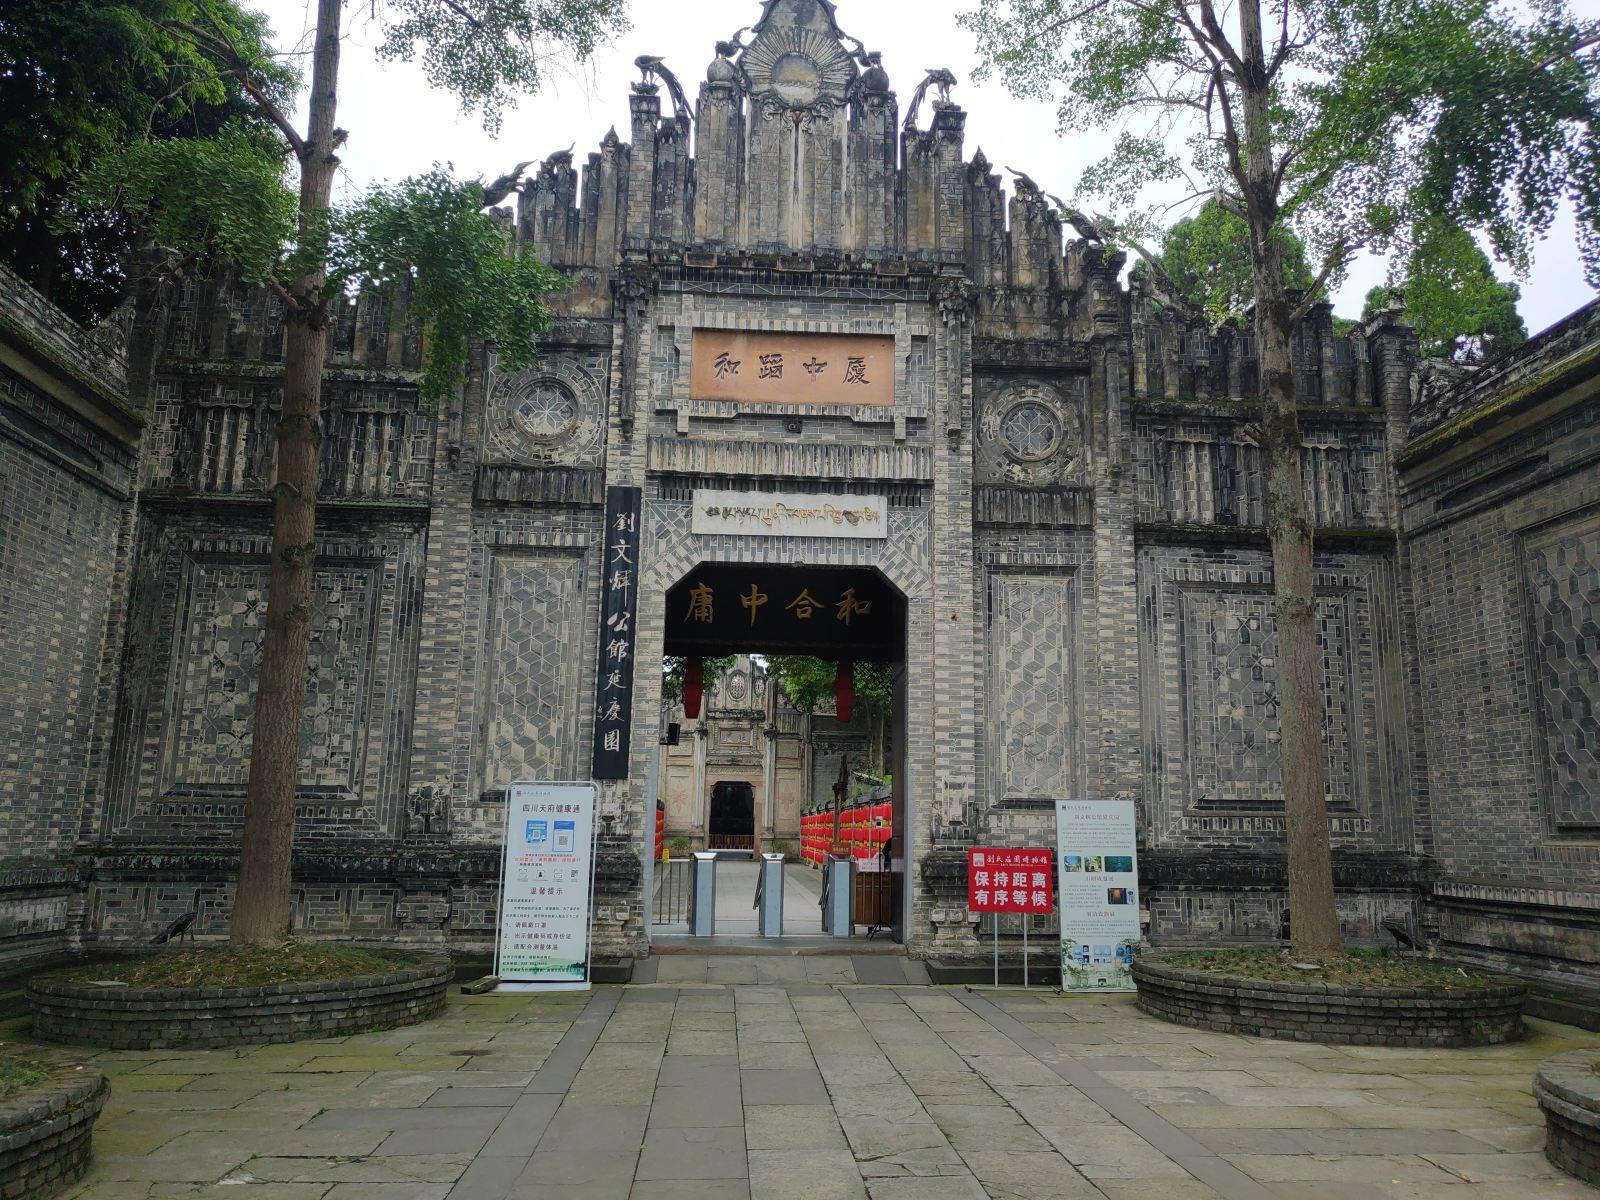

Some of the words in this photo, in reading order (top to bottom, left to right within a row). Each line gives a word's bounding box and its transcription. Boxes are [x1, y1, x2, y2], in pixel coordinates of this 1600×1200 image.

[522, 804, 580, 813] 四川天府健康通
[975, 871, 1046, 888] 保持距离
[530, 887, 564, 896] 温馨提示
[975, 890, 1046, 906] 有序等候
